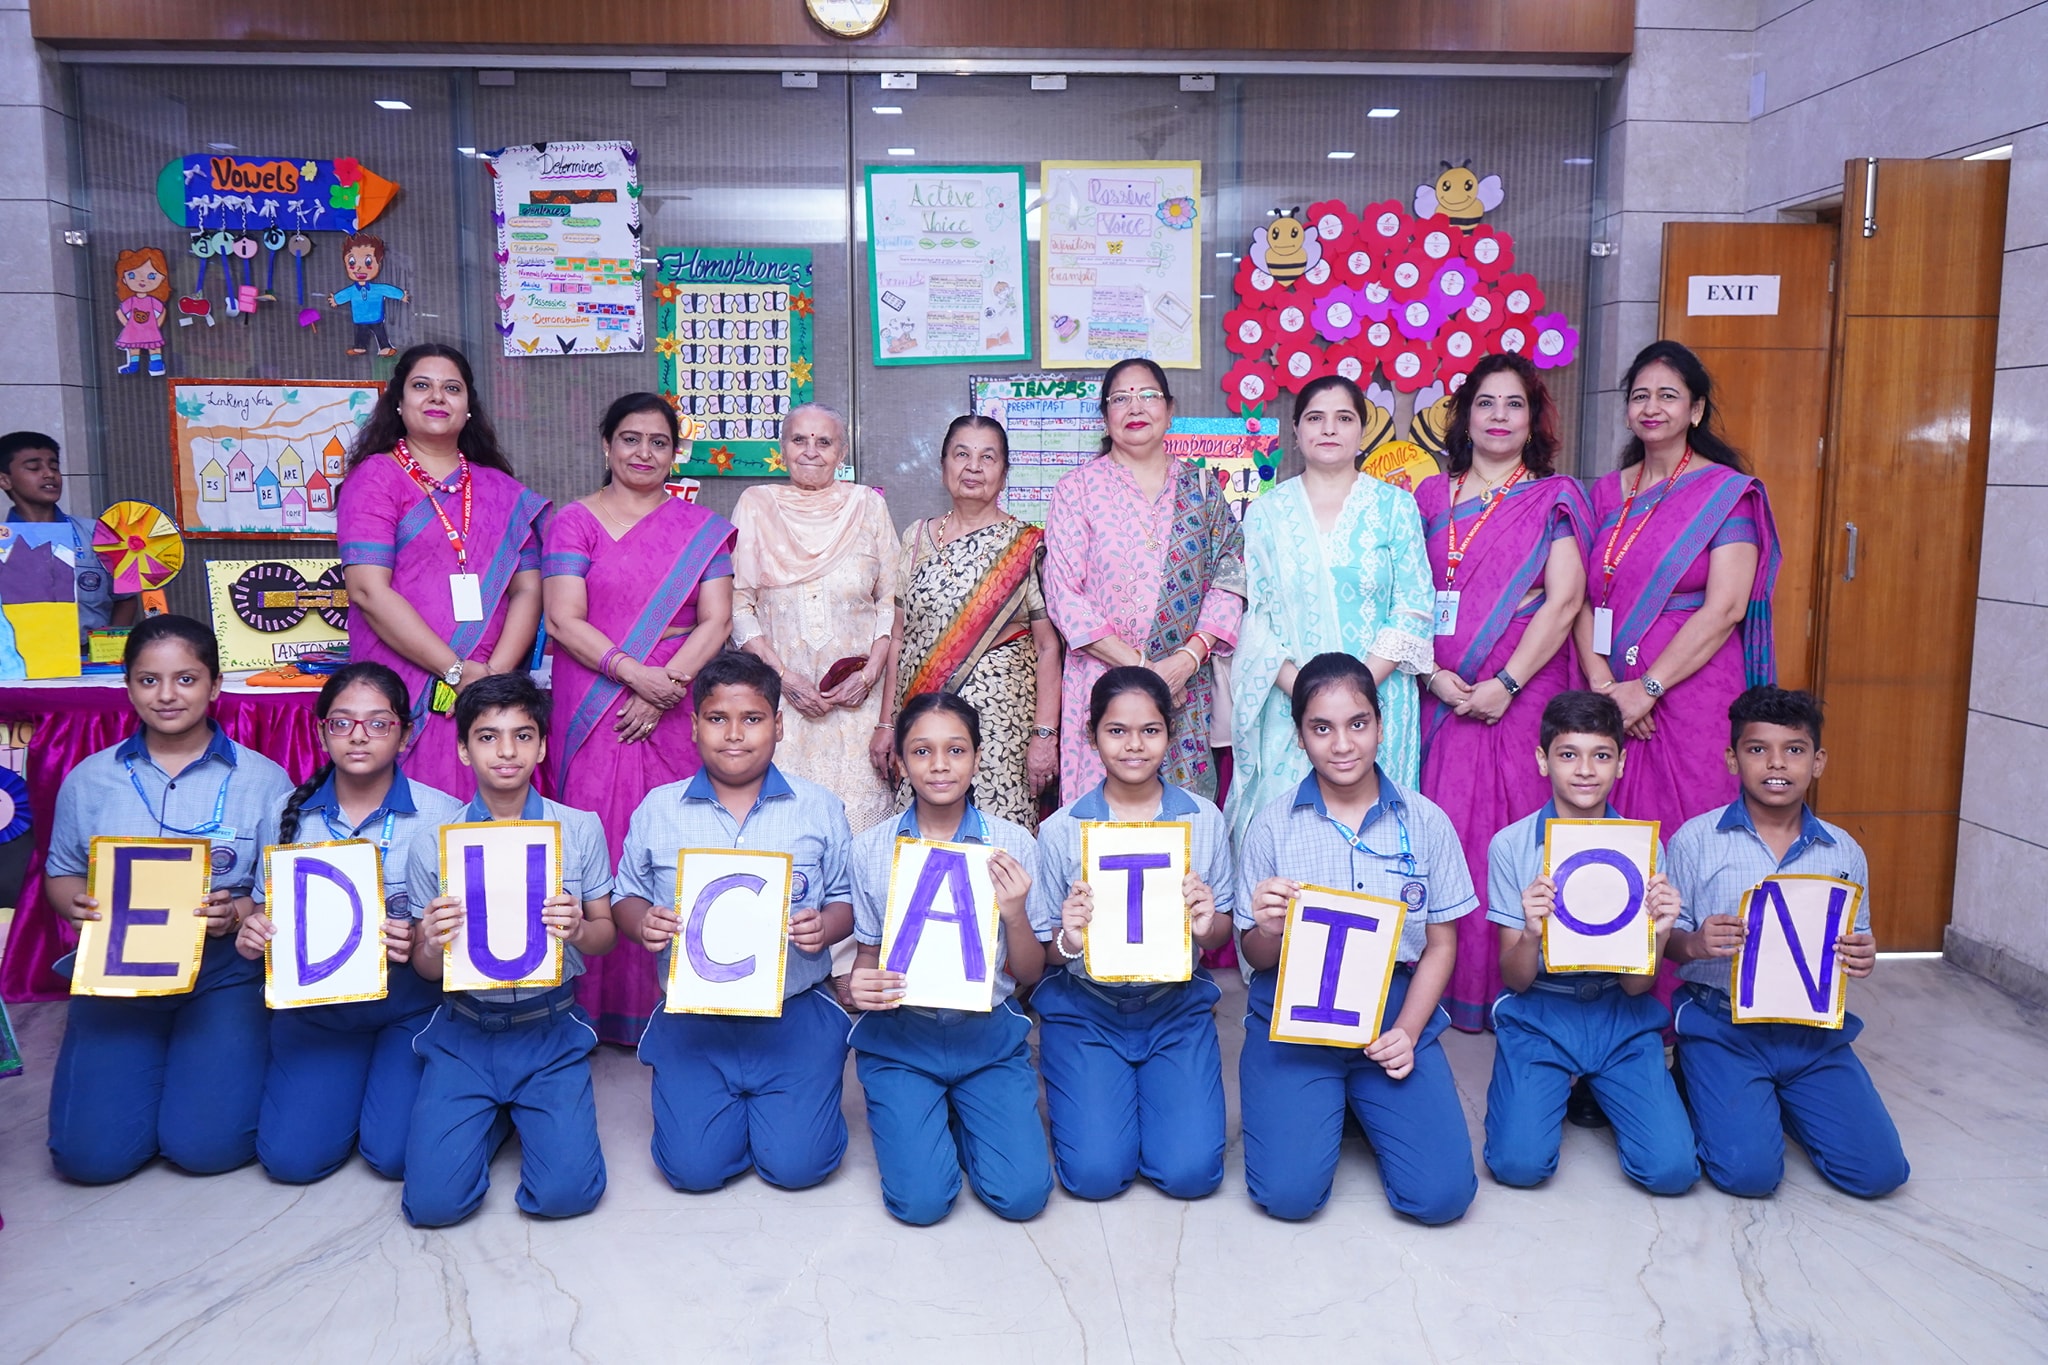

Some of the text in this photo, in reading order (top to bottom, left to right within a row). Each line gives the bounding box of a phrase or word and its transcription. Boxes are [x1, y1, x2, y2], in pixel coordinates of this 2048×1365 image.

[211, 158, 297, 192] Vowels
[537, 153, 605, 175] Determiners
[910, 180, 976, 207] Active
[1091, 179, 1152, 207] Passive
[199, 241, 209, 254] a
[241, 240, 247, 256] i
[663, 249, 802, 283] Homophones
[1707, 285, 1758, 301] EXIT
[1010, 380, 1086, 398] TENSES
[1008, 401, 1041, 413] PRESENT
[1042, 401, 1066, 412] PAST
[1163, 435, 1243, 458] omophones
[234, 472, 246, 482] AM
[283, 469, 298, 481] ARE
[328, 461, 340, 470] GO
[206, 481, 219, 491] IS
[262, 489, 272, 500] BE
[312, 492, 327, 505] WAS
[286, 509, 302, 518] COME
[1459, 500, 1499, 552] ARYA MODEL SCHOOL
[1603, 506, 1629, 564] ARYA MODEL SCHOOL
[1613, 549, 1626, 566] ARYA
[1622, 532, 1637, 552] MODEL
[1099, 853, 1171, 944] T
[1552, 848, 1646, 937] O
[104, 847, 193, 977] E
[294, 856, 364, 987] D
[463, 843, 548, 981] U
[885, 847, 986, 983] A
[685, 873, 768, 983] C
[1740, 880, 1848, 1014] N
[1290, 906, 1380, 1027] I
